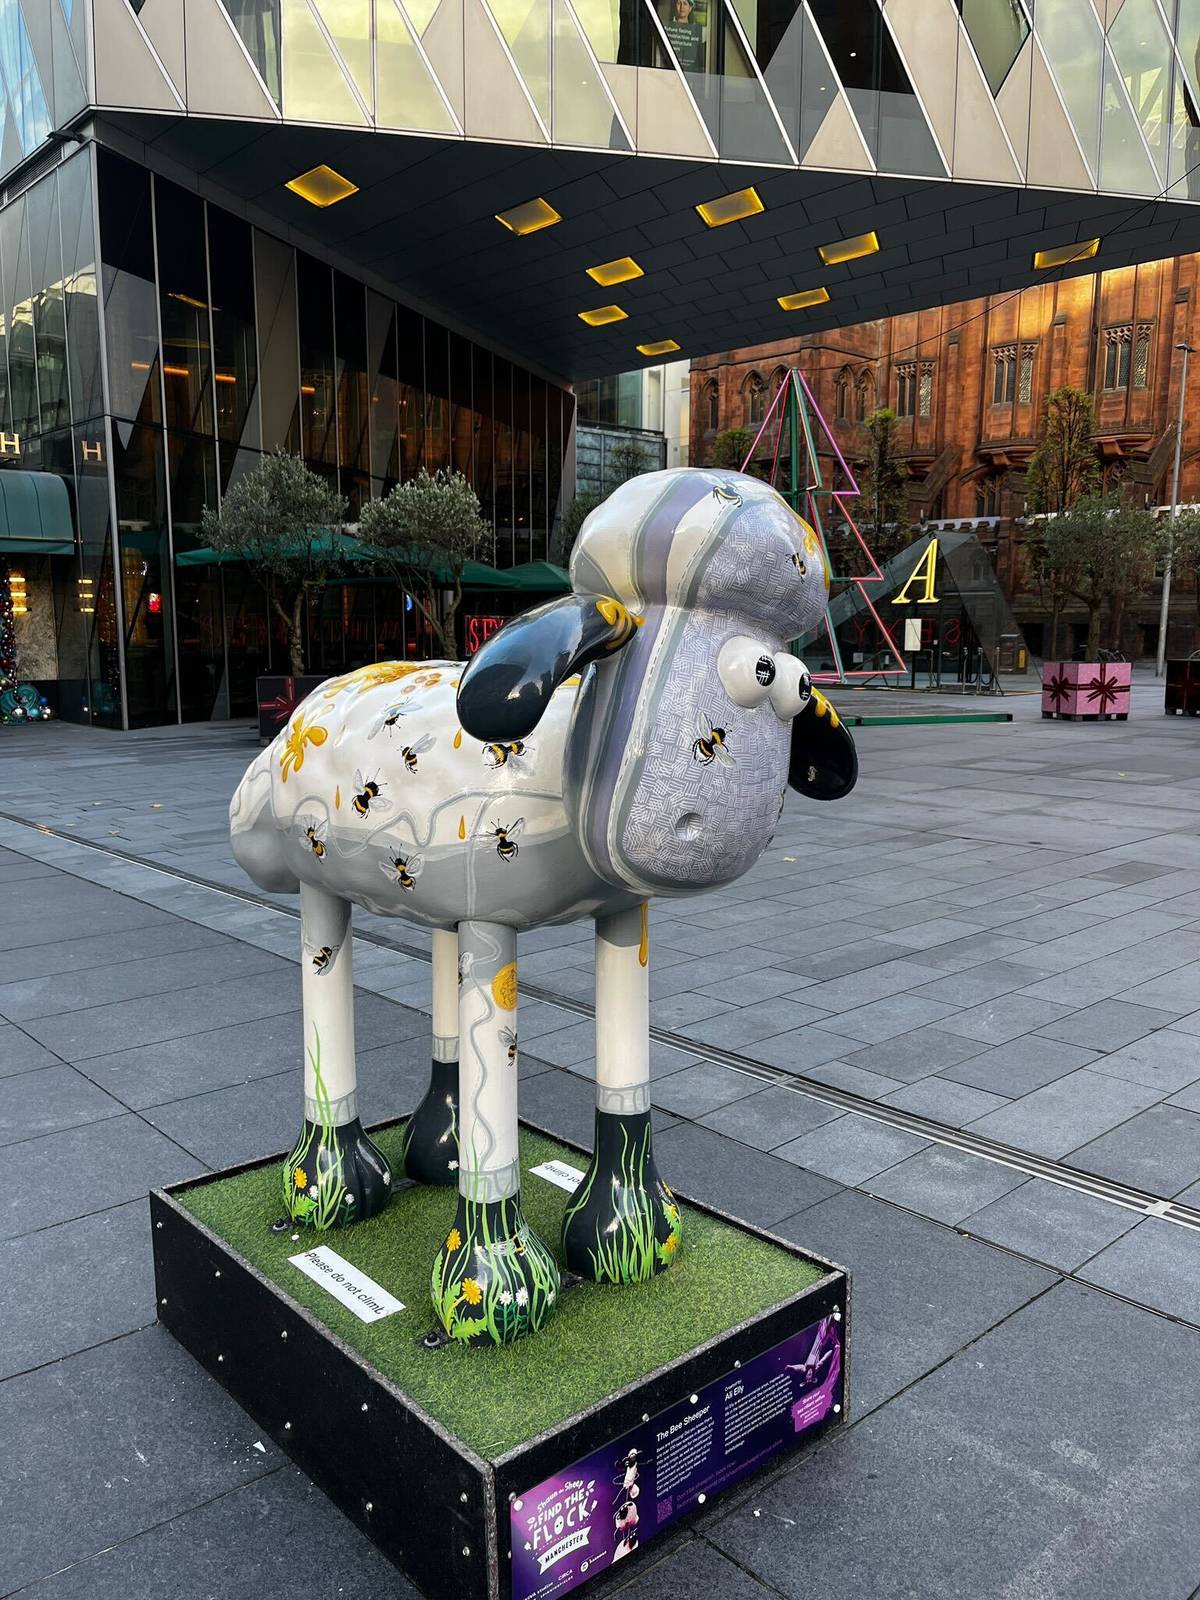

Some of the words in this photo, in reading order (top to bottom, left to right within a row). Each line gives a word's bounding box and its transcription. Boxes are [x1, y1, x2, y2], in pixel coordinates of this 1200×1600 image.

[891, 538, 941, 604] A
[304, 1251, 334, 1274] Please
[330, 1272, 345, 1283] do
[342, 1281, 362, 1295] not
[656, 1430, 670, 1442] The
[669, 1421, 683, 1434] Bee
[683, 1405, 710, 1426] Sheeper
[537, 1491, 558, 1513] Shaun
[537, 1501, 563, 1526] FIND
[564, 1488, 585, 1509] THE
[533, 1497, 590, 1551] FLOCK
[544, 1533, 584, 1564] MANCHESTER
